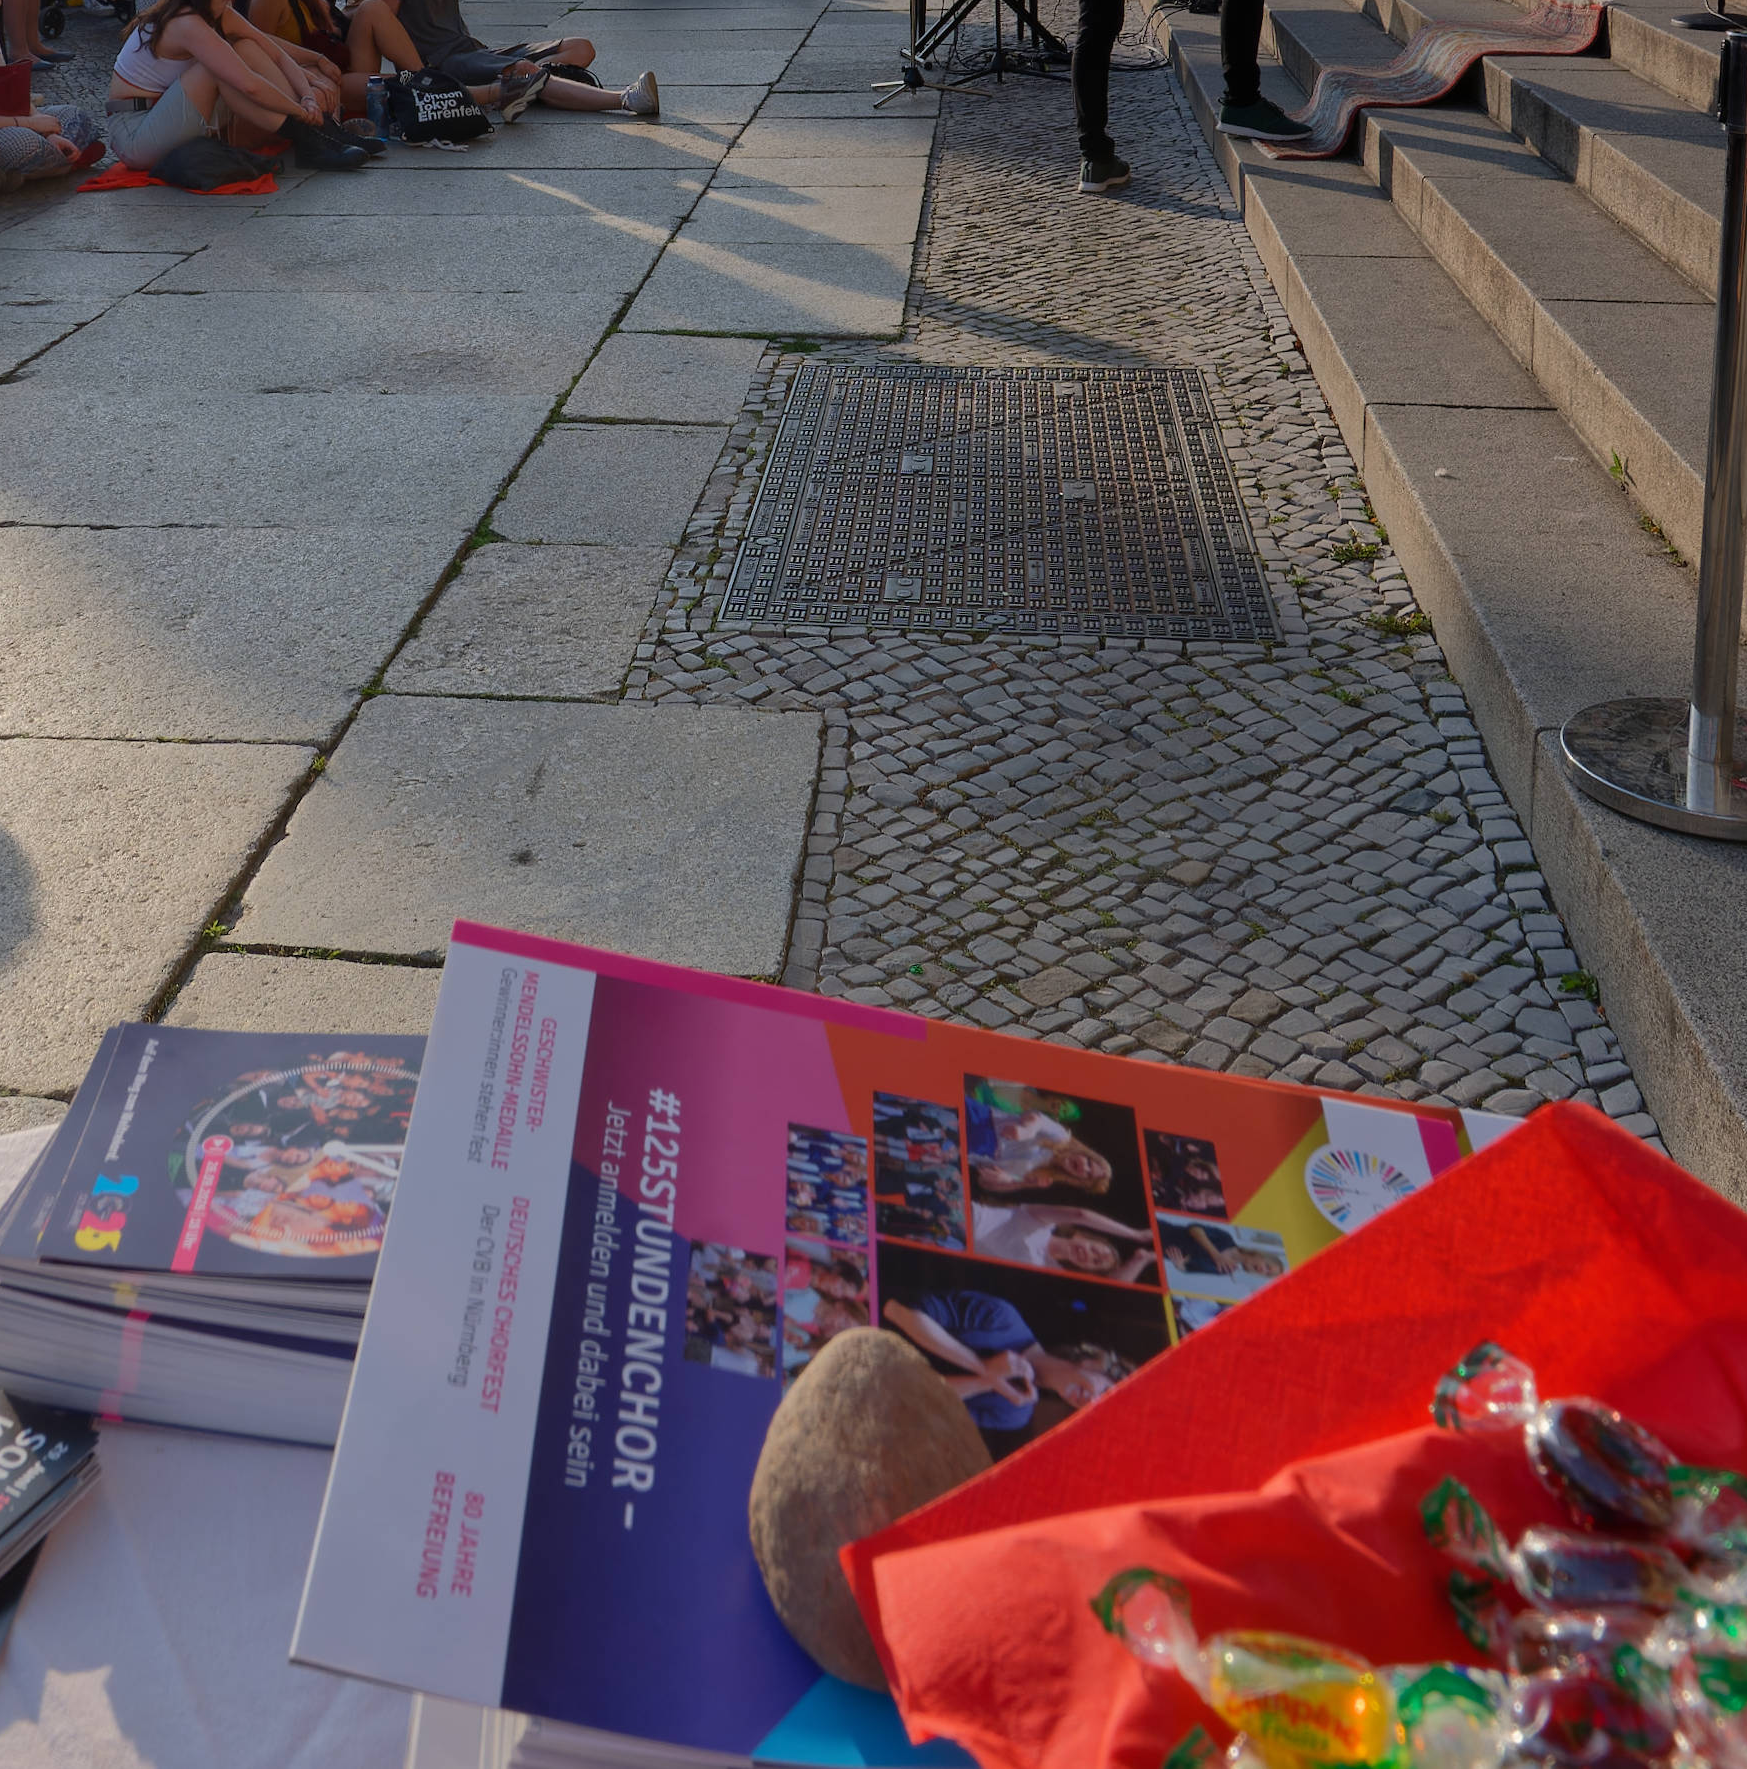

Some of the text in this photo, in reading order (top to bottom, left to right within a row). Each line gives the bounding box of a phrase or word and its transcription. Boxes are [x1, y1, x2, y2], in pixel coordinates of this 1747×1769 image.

[417, 99, 457, 113] Tokyo
[466, 966, 517, 1164] Gewinner:innen stehen fest
[490, 970, 539, 1171] MENDELSSOHN-MEDAILLE
[525, 1016, 556, 1134] GESCHWISTER-
[472, 1235, 494, 1274] CVB
[478, 1204, 499, 1234] Der
[447, 1296, 483, 1387] Nürnberg
[479, 1196, 530, 1413] DEUTSCHES CHORFEST
[562, 1100, 632, 1487] Jetzt anmelden und dabei sein
[610, 1089, 681, 1494] #125STUNDENCHOR
[415, 1470, 456, 1599] BEFREIUNG
[450, 1490, 485, 1597] 80 JAHRE
